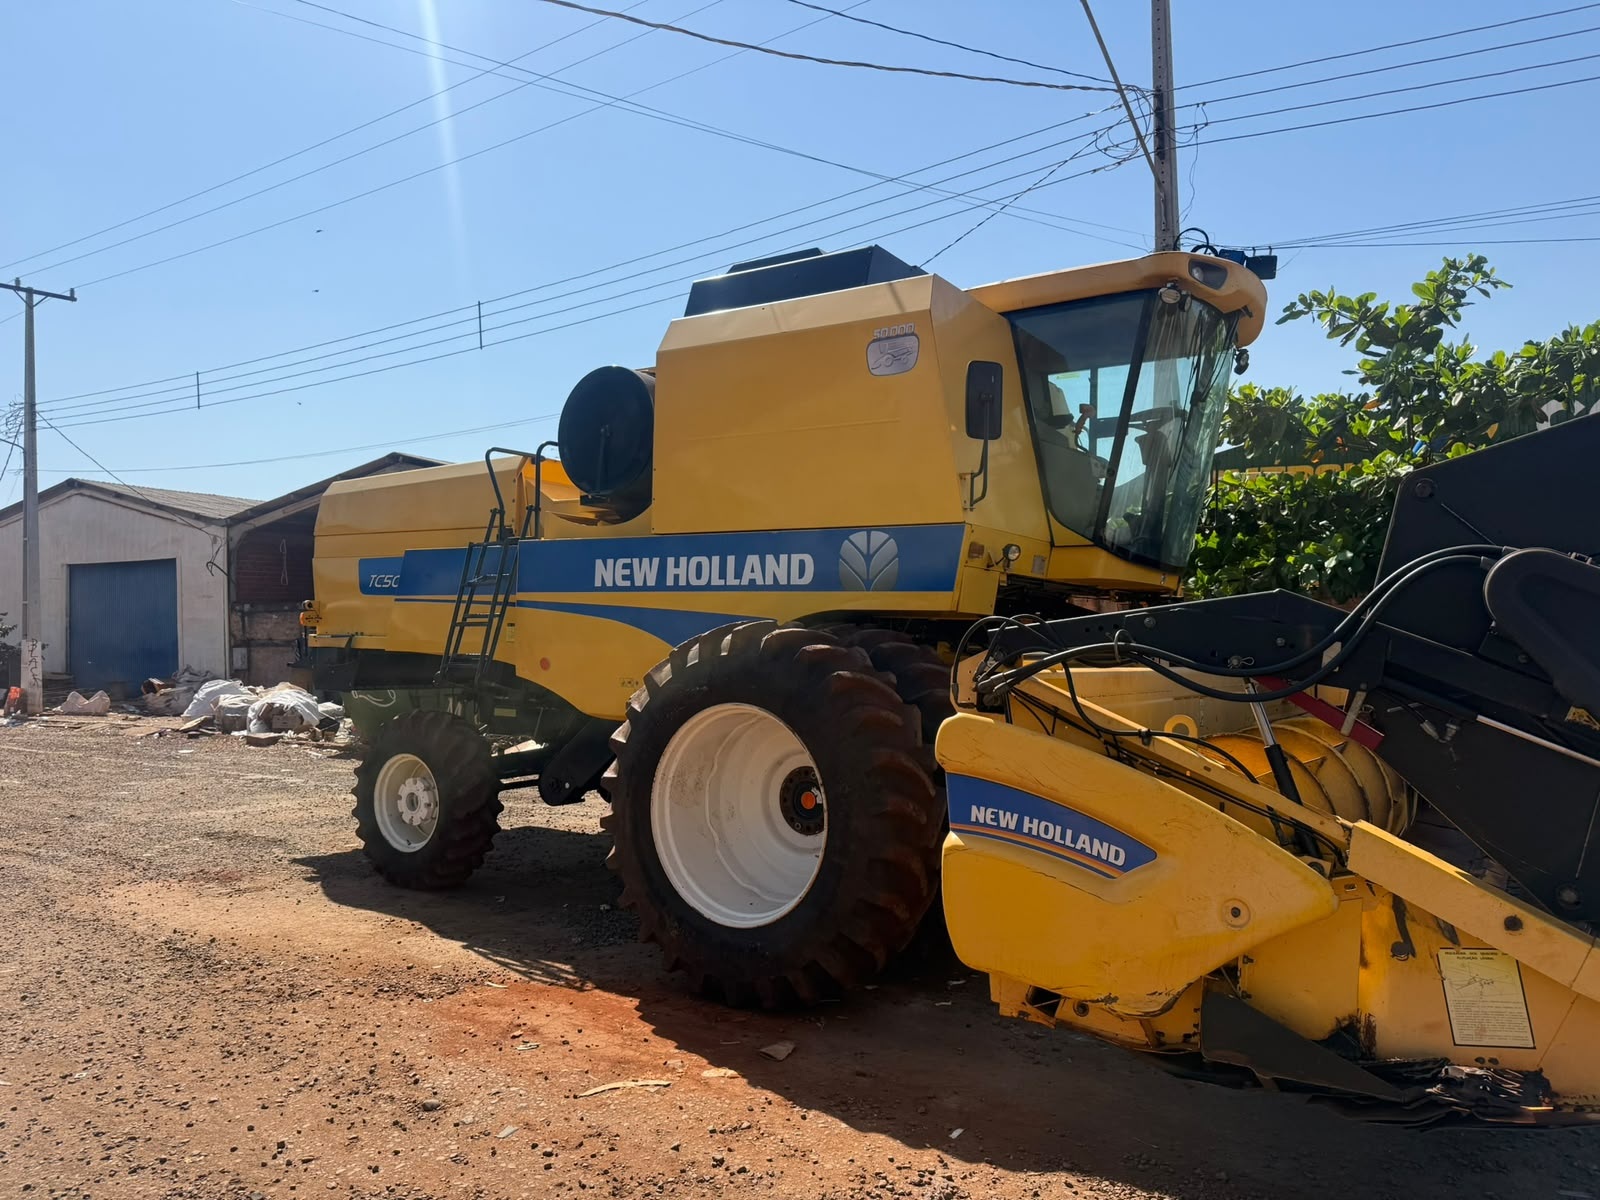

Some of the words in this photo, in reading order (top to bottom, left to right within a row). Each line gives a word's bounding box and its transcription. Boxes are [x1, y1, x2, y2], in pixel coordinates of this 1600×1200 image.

[594, 557, 660, 587] NEW
[666, 553, 815, 586] HOLLAND
[970, 804, 1019, 831] NEW
[1023, 815, 1126, 867] HOLLAND
